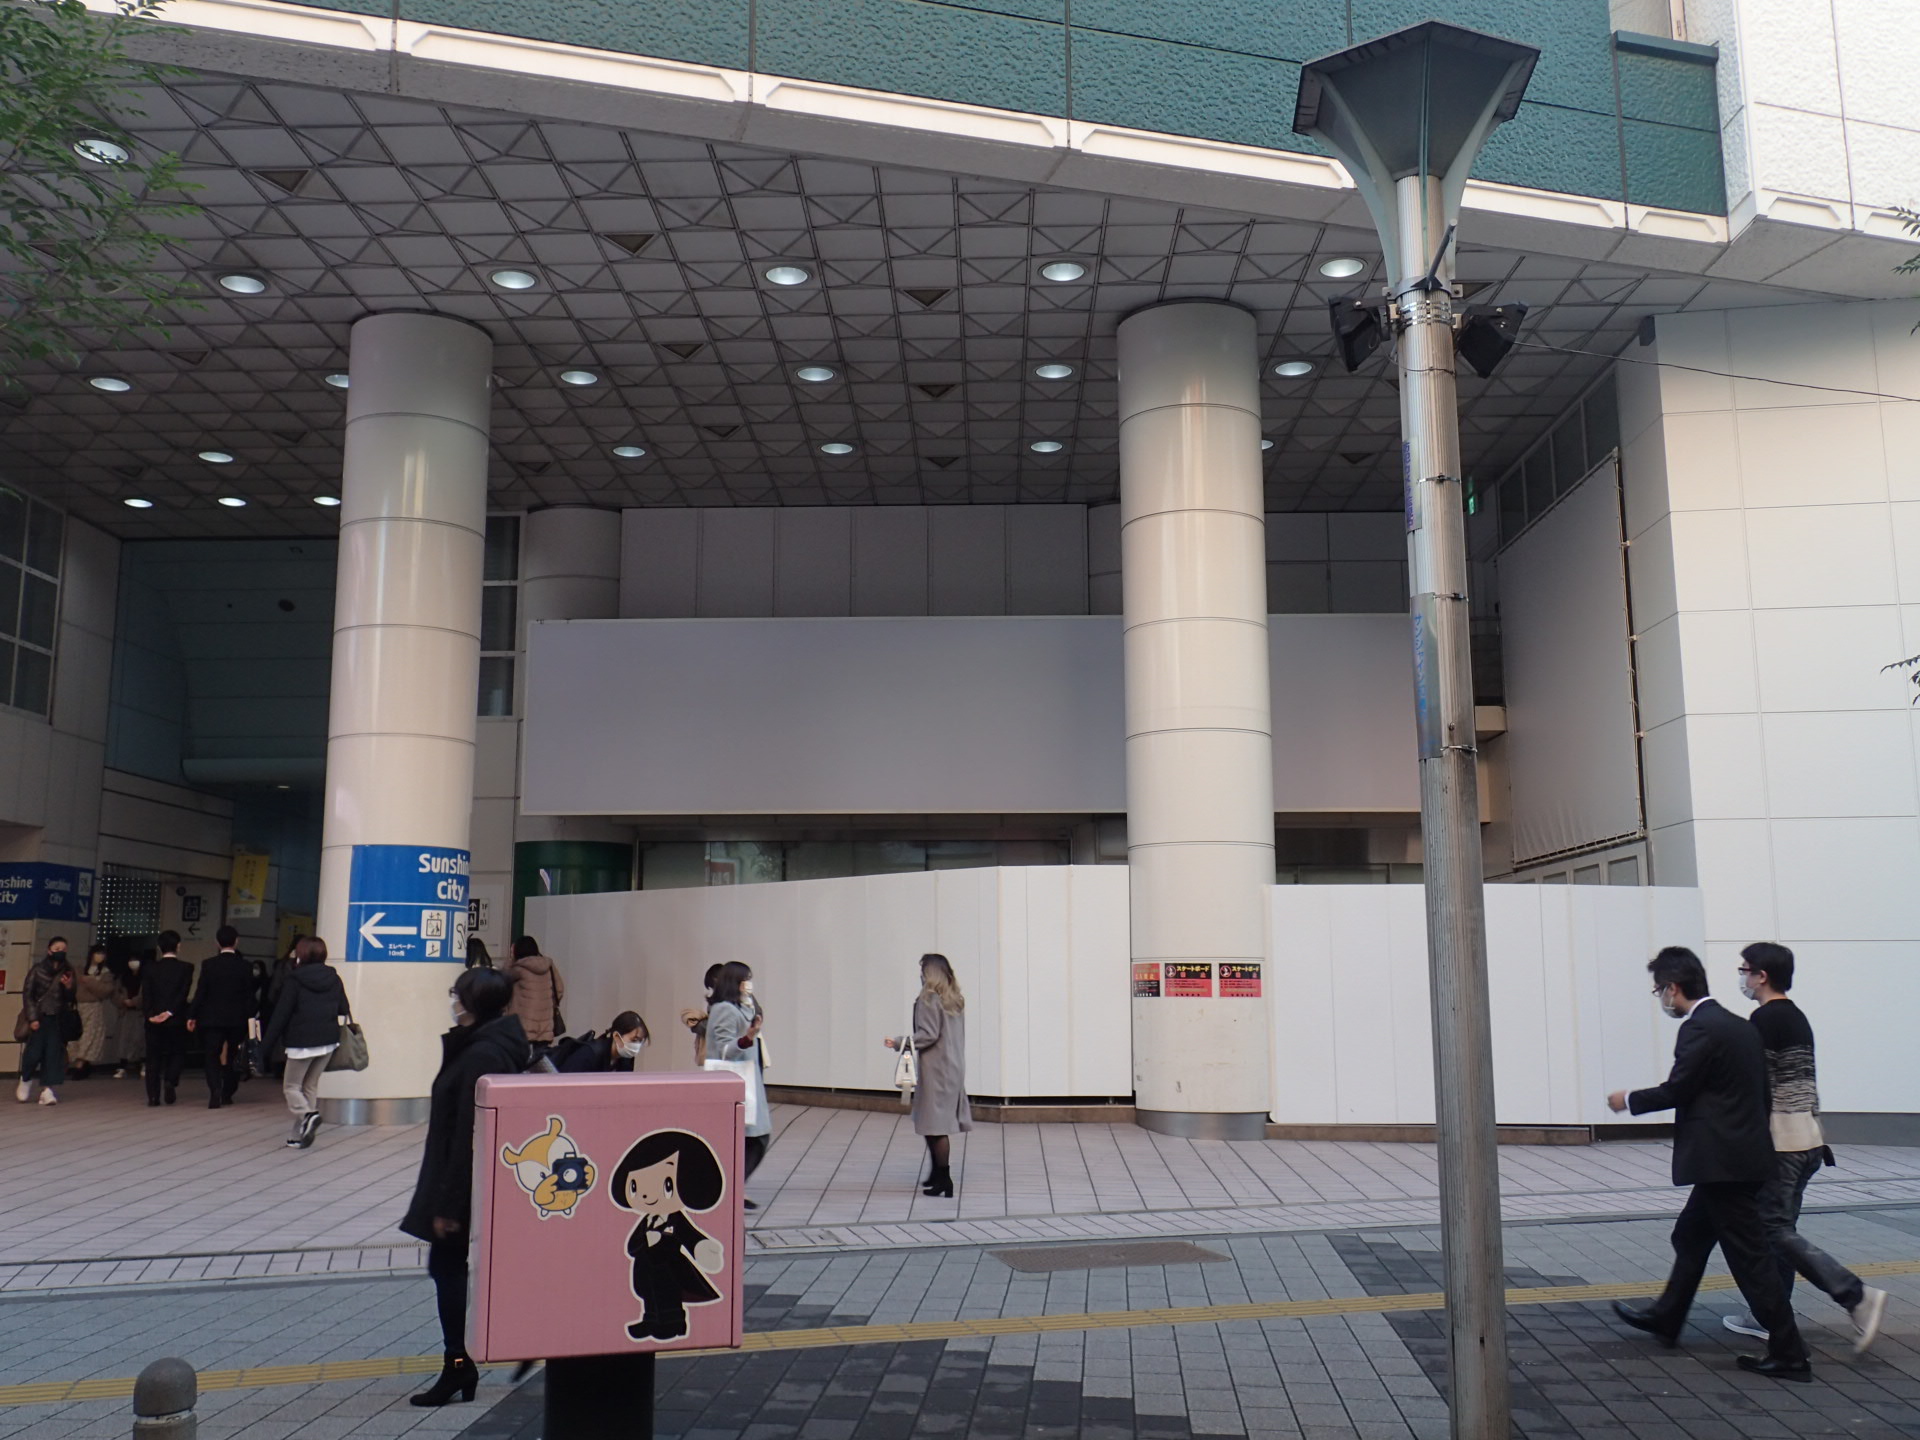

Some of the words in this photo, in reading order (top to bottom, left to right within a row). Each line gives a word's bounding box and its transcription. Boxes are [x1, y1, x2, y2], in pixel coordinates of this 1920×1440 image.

[437, 878, 464, 902] City
[0, 891, 19, 904] ity
[50, 892, 63, 906] City
